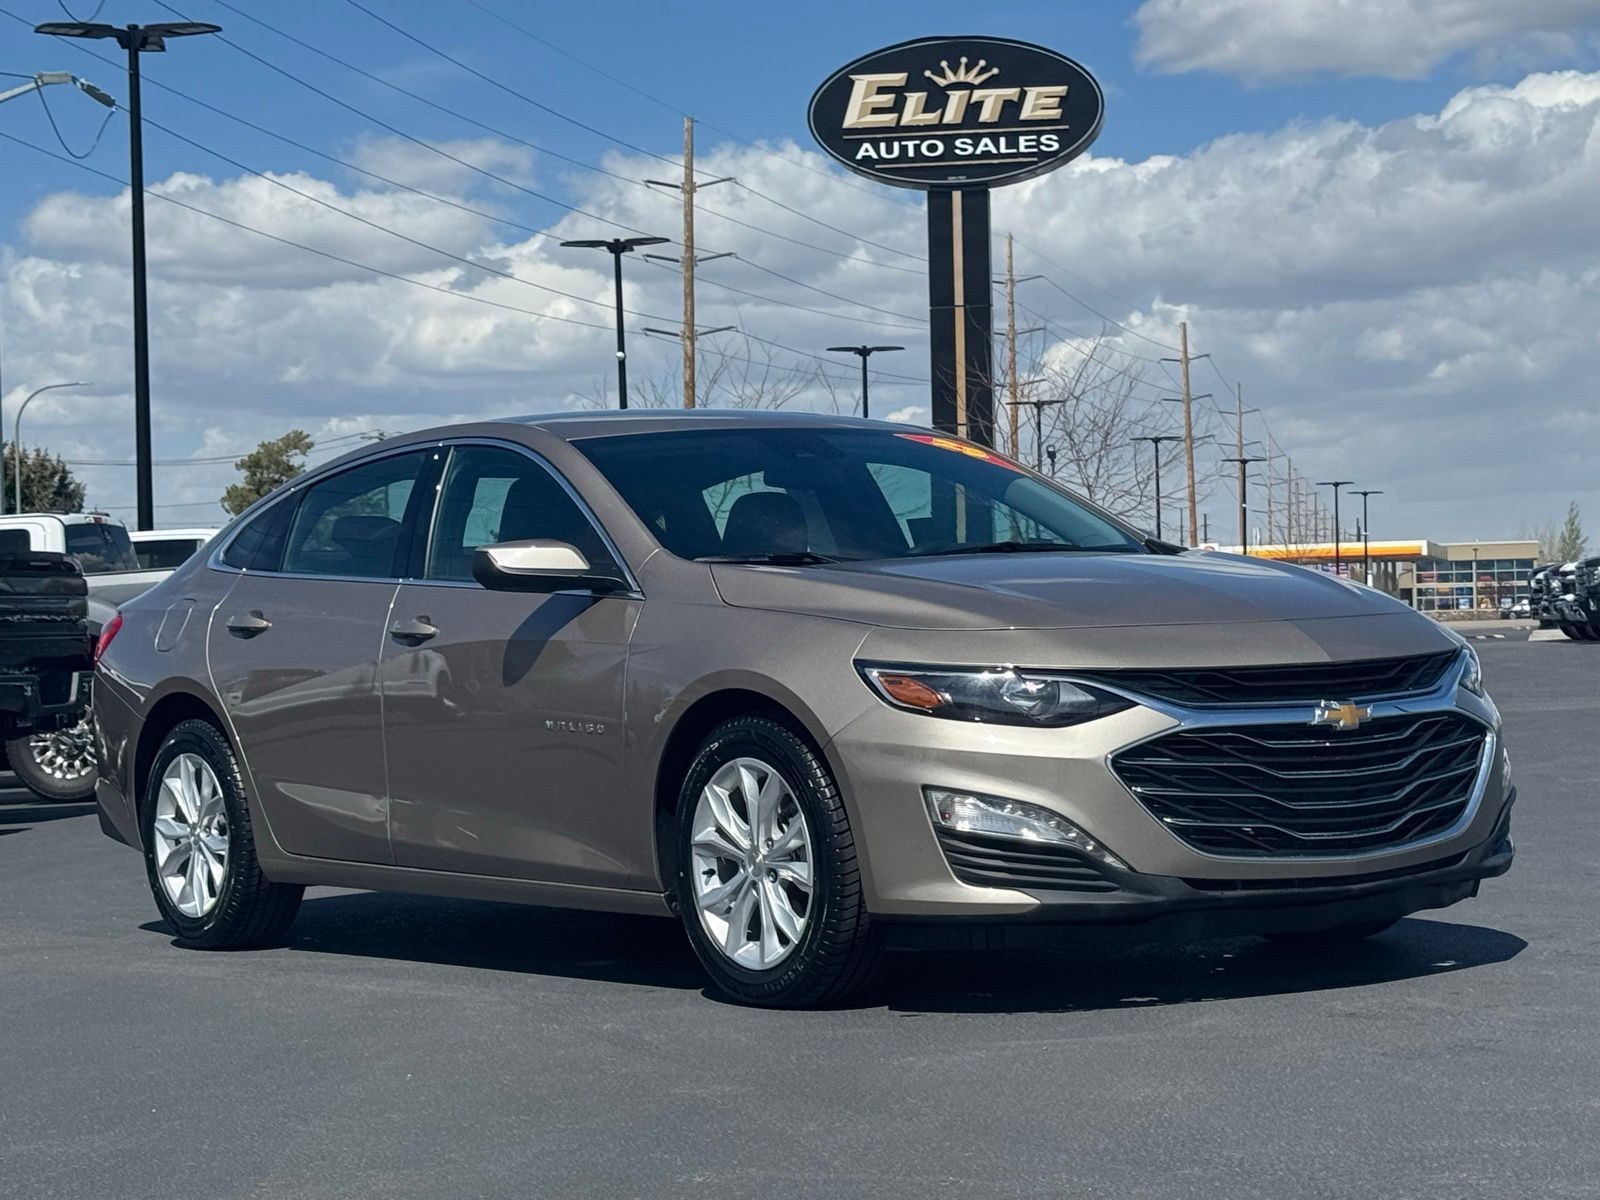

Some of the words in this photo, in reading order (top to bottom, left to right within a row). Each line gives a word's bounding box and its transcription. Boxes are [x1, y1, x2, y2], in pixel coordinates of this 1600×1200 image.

[842, 72, 1069, 129] ELITE
[855, 139, 945, 160] AUTO
[954, 134, 1060, 156] SALES
